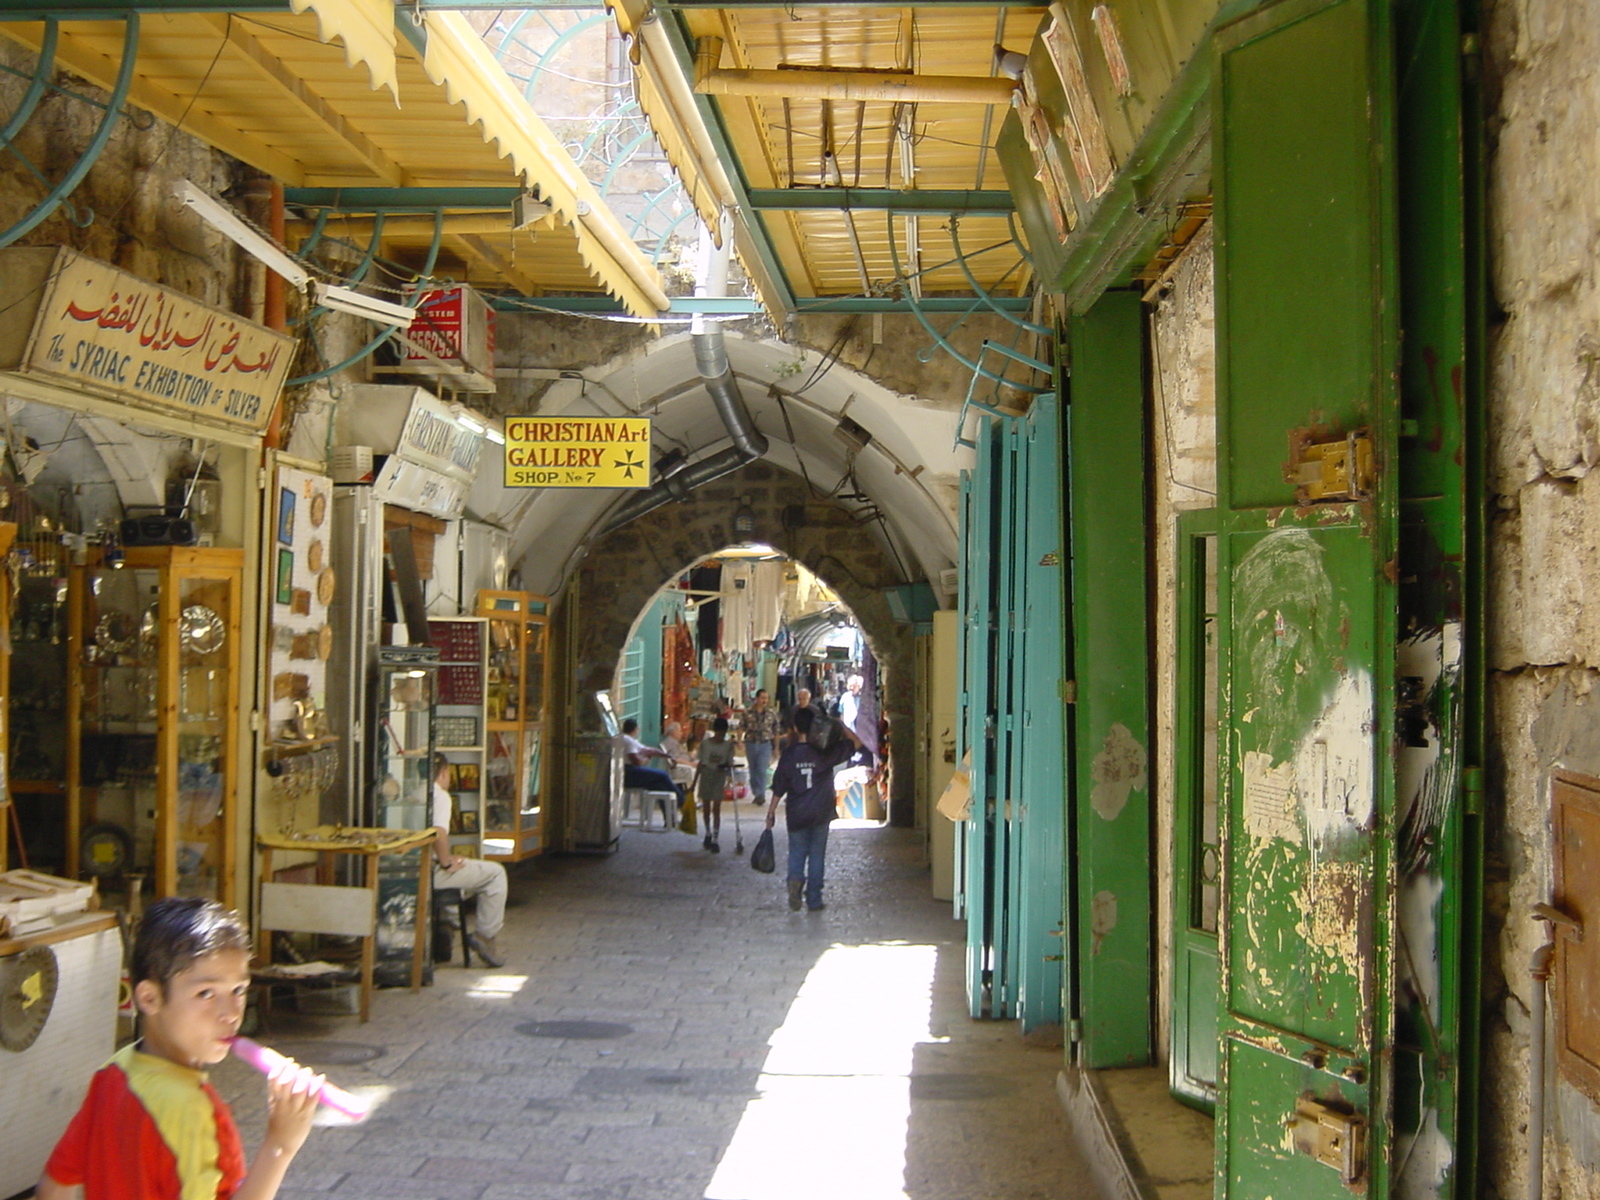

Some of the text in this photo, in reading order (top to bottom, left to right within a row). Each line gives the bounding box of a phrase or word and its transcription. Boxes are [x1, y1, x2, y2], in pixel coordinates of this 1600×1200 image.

[47, 334, 261, 420] The SYRIAC EXHIBITION OF SILVER
[508, 423, 648, 442] CHRISTIAN Art
[508, 448, 606, 467] GALLERY
[586, 472, 596, 483] 7
[801, 768, 812, 788] 7
